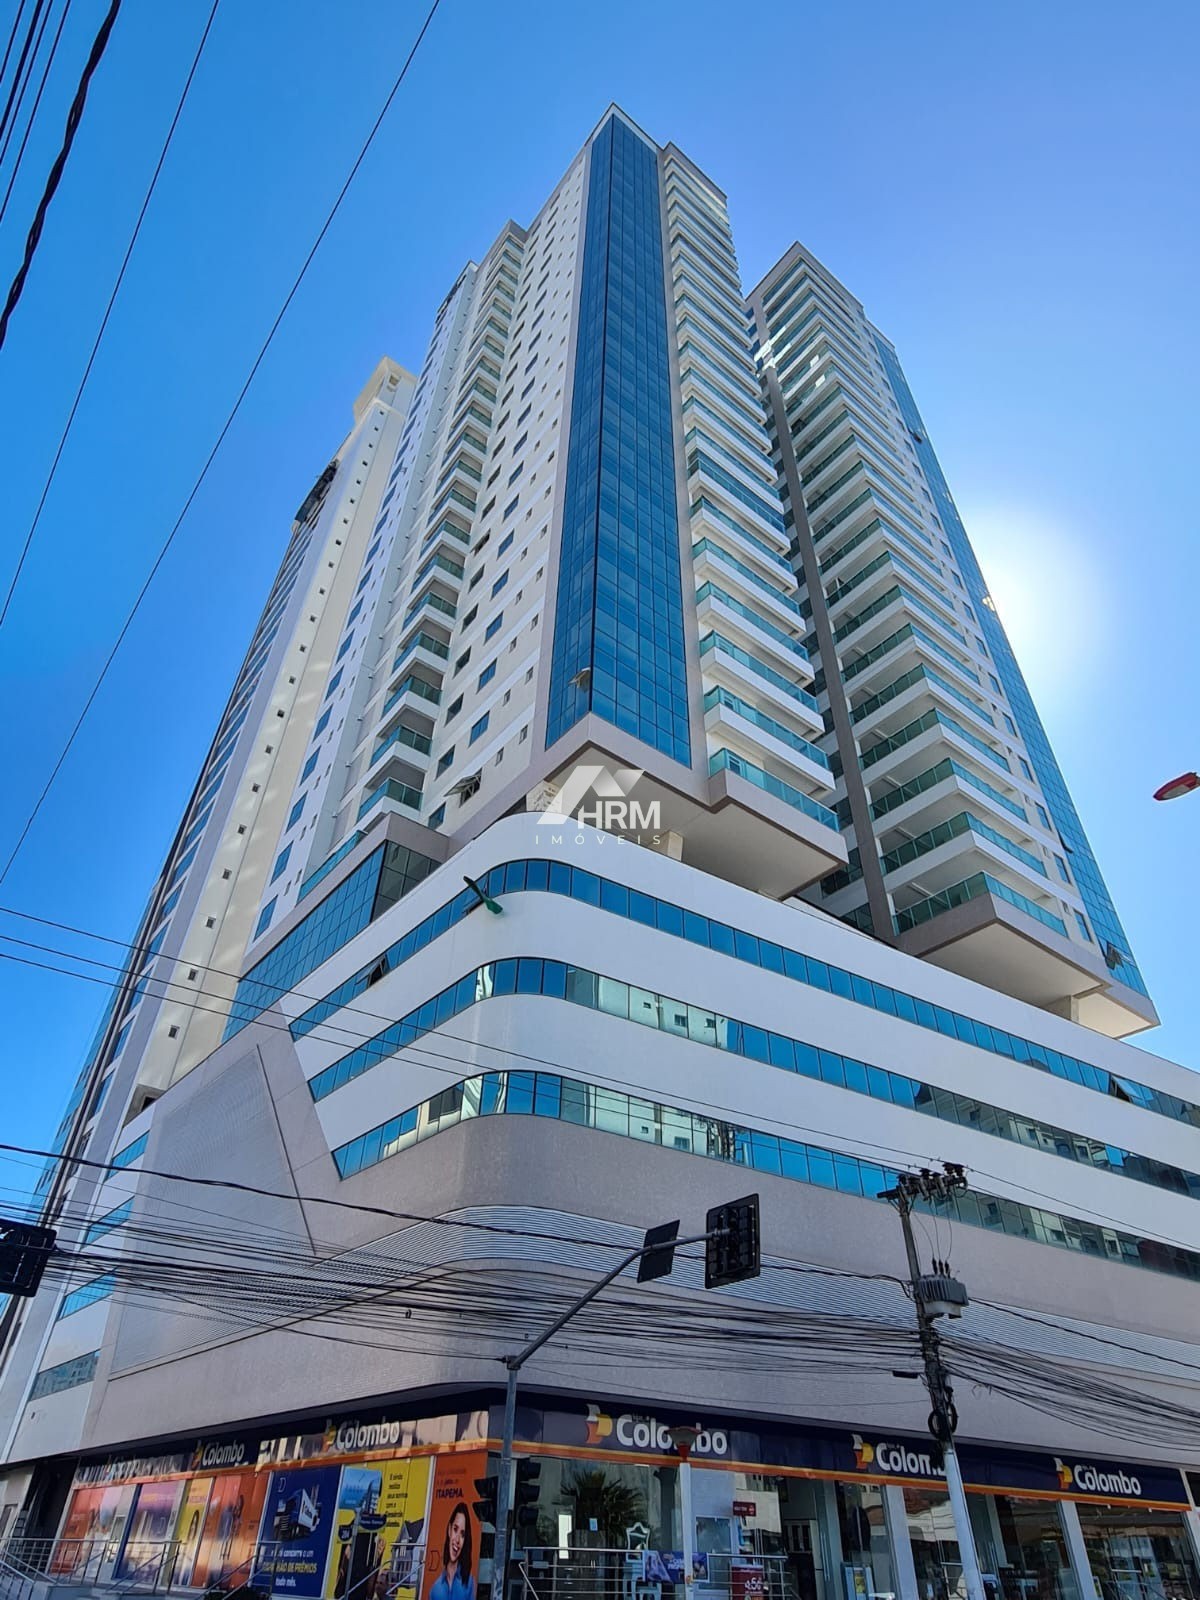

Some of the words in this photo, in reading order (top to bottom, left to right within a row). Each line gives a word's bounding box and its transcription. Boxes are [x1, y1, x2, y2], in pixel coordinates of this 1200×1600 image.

[336, 1416, 400, 1450] Colombo
[616, 1414, 728, 1455] Colobo
[202, 1440, 245, 1466] Colombo
[436, 1488, 464, 1499] ITAPEMA
[1074, 1464, 1142, 1496] Colombo
